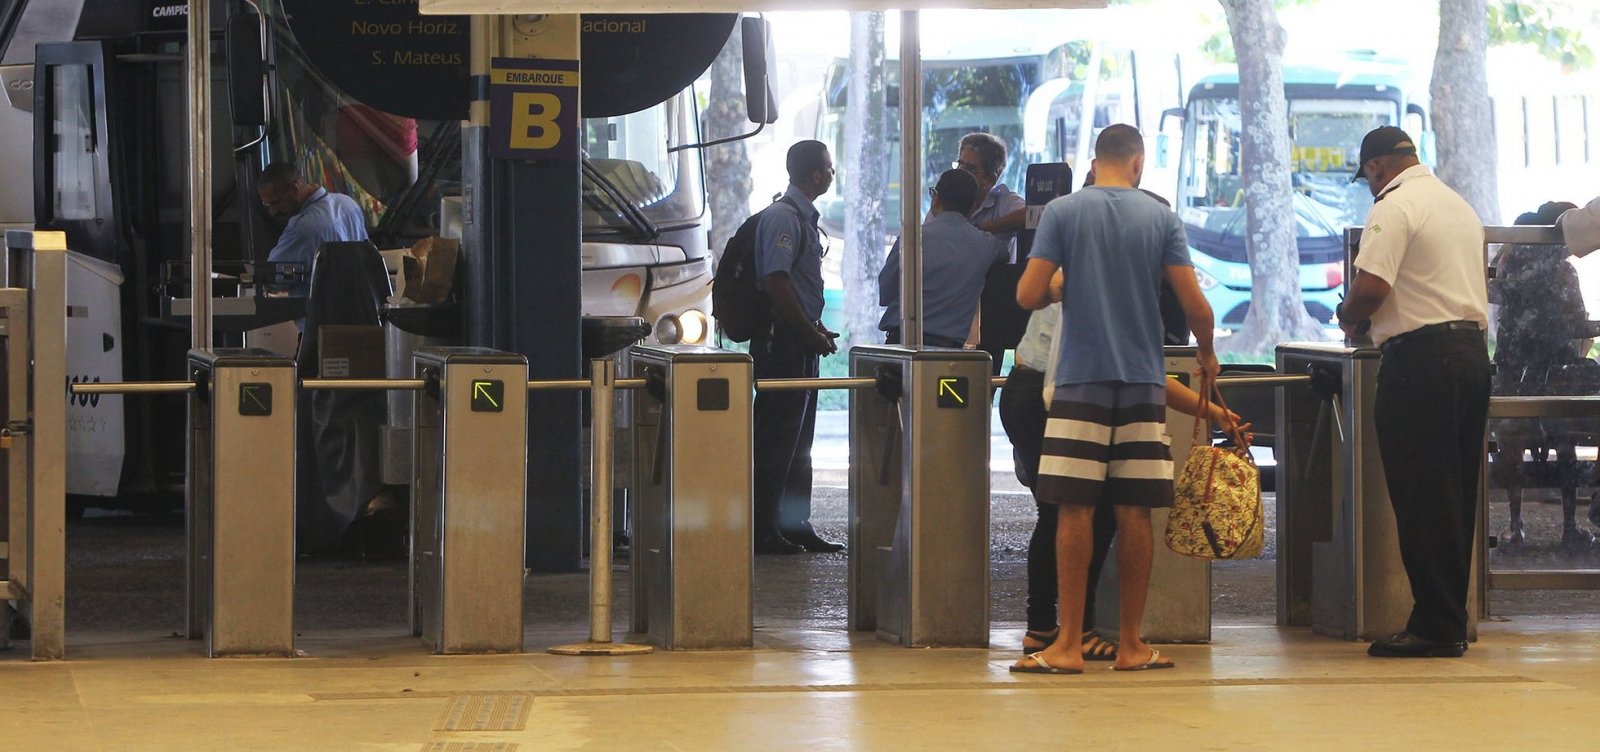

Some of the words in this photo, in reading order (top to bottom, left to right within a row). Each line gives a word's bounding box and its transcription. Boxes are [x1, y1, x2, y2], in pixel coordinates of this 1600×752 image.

[351, 20, 402, 34] Novo
[371, 50, 387, 65] S.
[394, 51, 462, 65] Mateus
[506, 72, 564, 84] EMBARQUE
[509, 92, 562, 149] B
